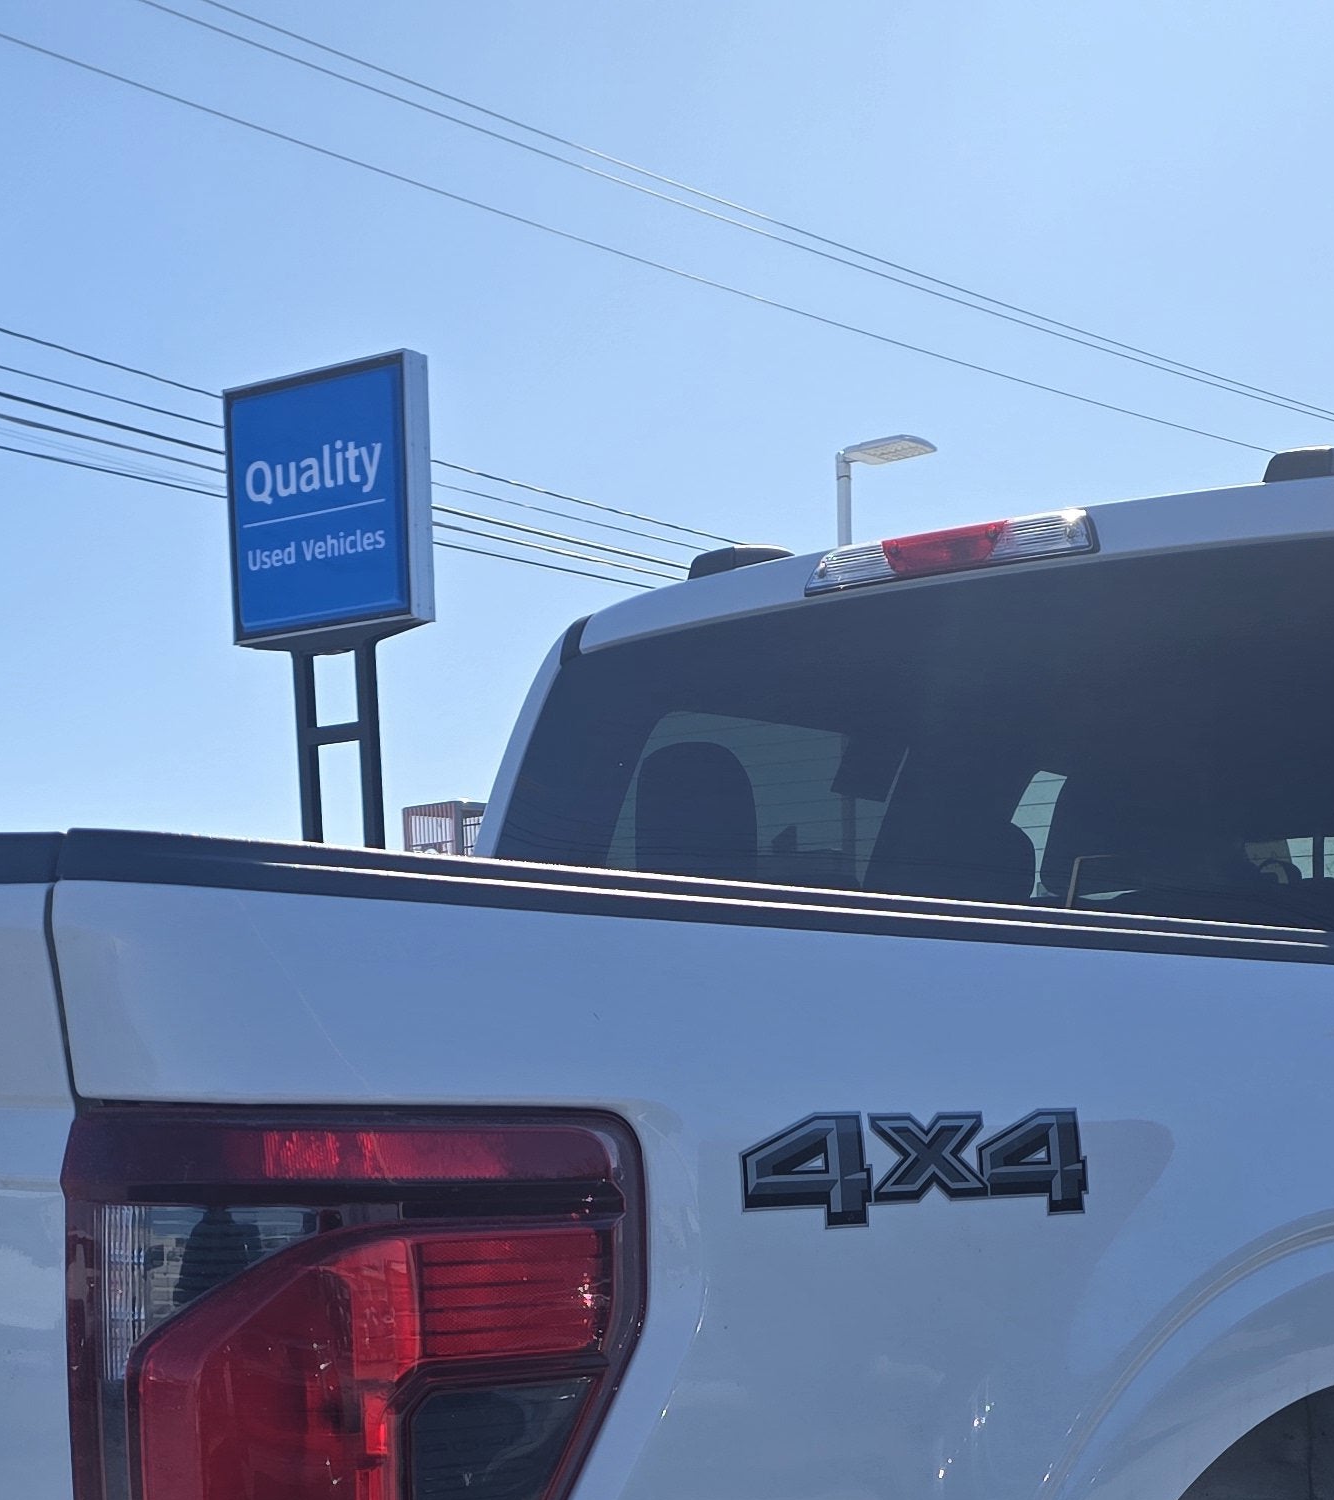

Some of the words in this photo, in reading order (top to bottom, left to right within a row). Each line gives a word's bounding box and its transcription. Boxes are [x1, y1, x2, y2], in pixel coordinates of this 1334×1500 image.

[245, 440, 383, 504] Quality
[248, 541, 296, 571] Used
[301, 529, 386, 561] Vehicles
